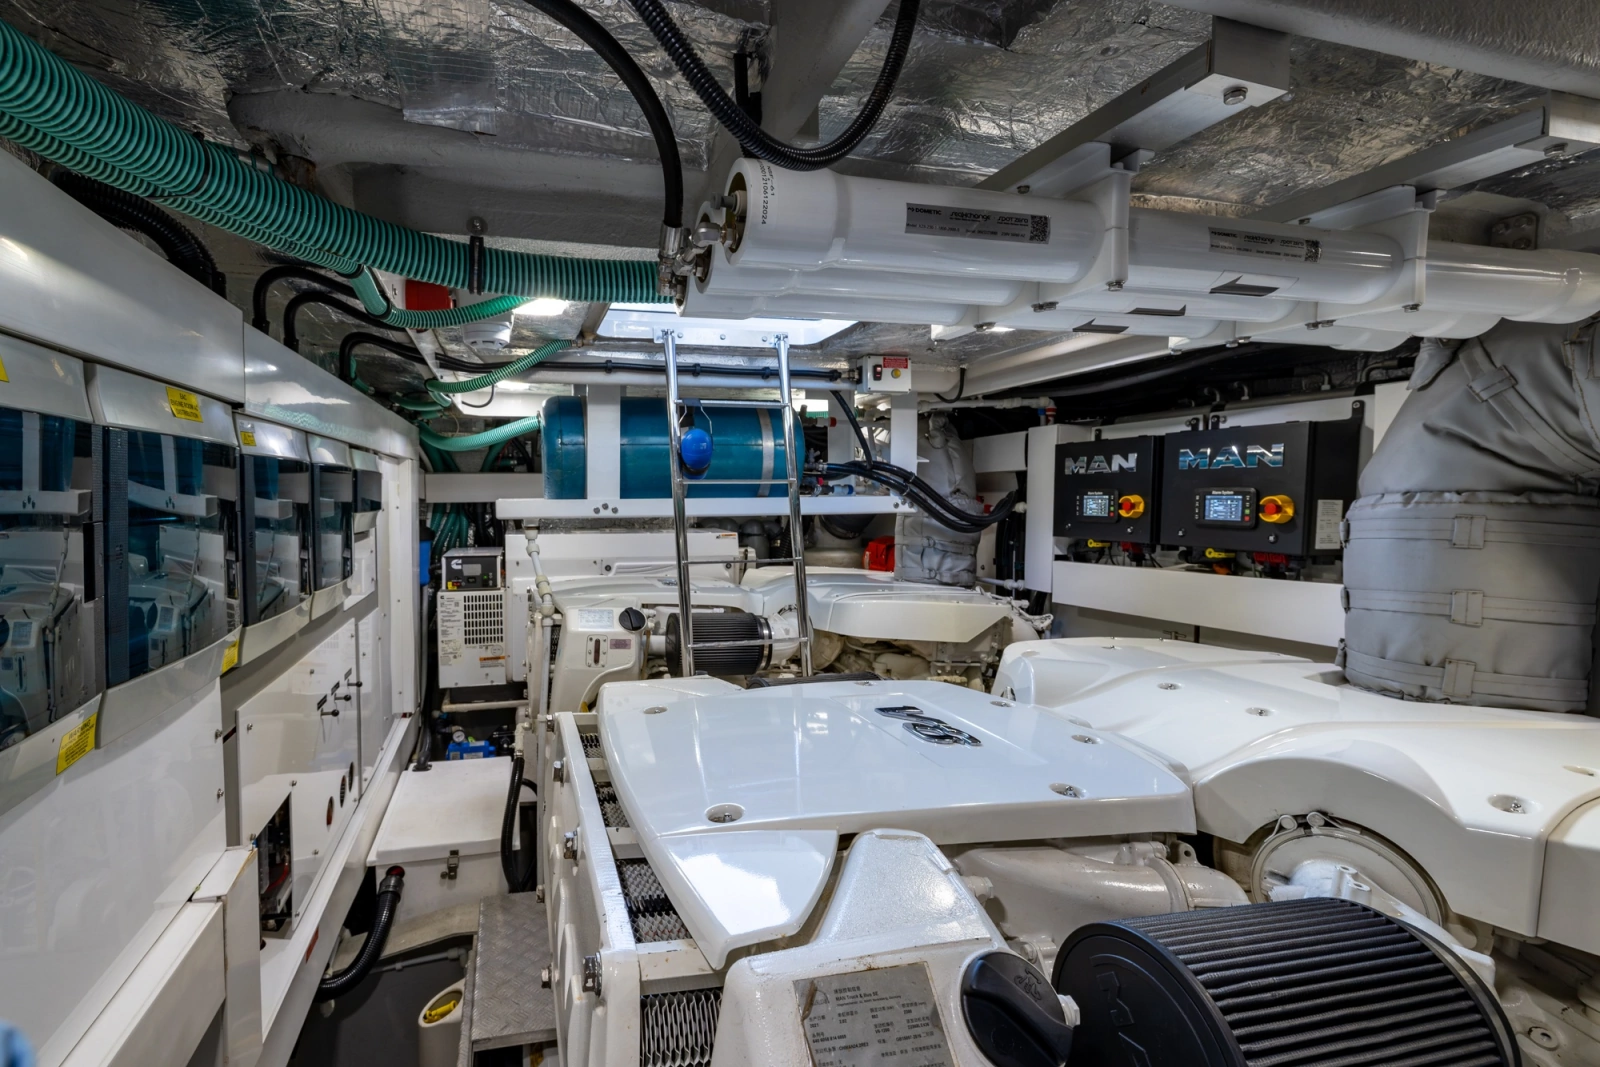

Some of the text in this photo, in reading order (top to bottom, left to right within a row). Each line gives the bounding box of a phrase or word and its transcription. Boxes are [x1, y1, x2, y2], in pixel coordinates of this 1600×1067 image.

[915, 207, 942, 216] DOMETIC
[1064, 453, 1138, 475] MAN
[1178, 443, 1285, 470] MAN
[69, 719, 91, 740] WARNING
